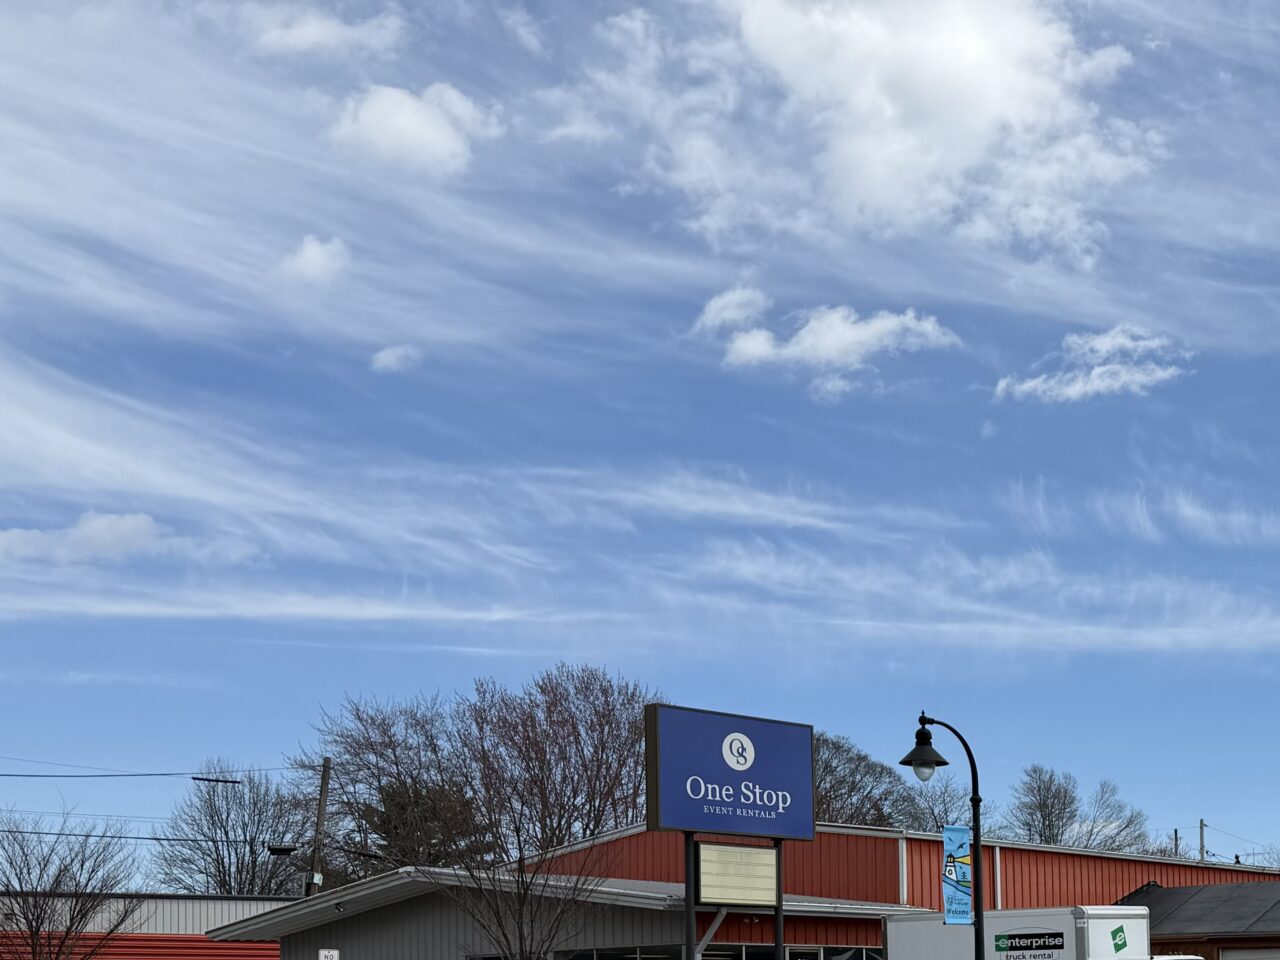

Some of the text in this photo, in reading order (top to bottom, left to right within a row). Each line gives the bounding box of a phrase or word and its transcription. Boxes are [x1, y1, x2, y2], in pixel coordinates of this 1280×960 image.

[686, 775, 791, 813] One Stop
[703, 805, 776, 819] EVENT RENTALS
[998, 935, 1064, 949] enterprise
[1005, 951, 1054, 960] truck rental
